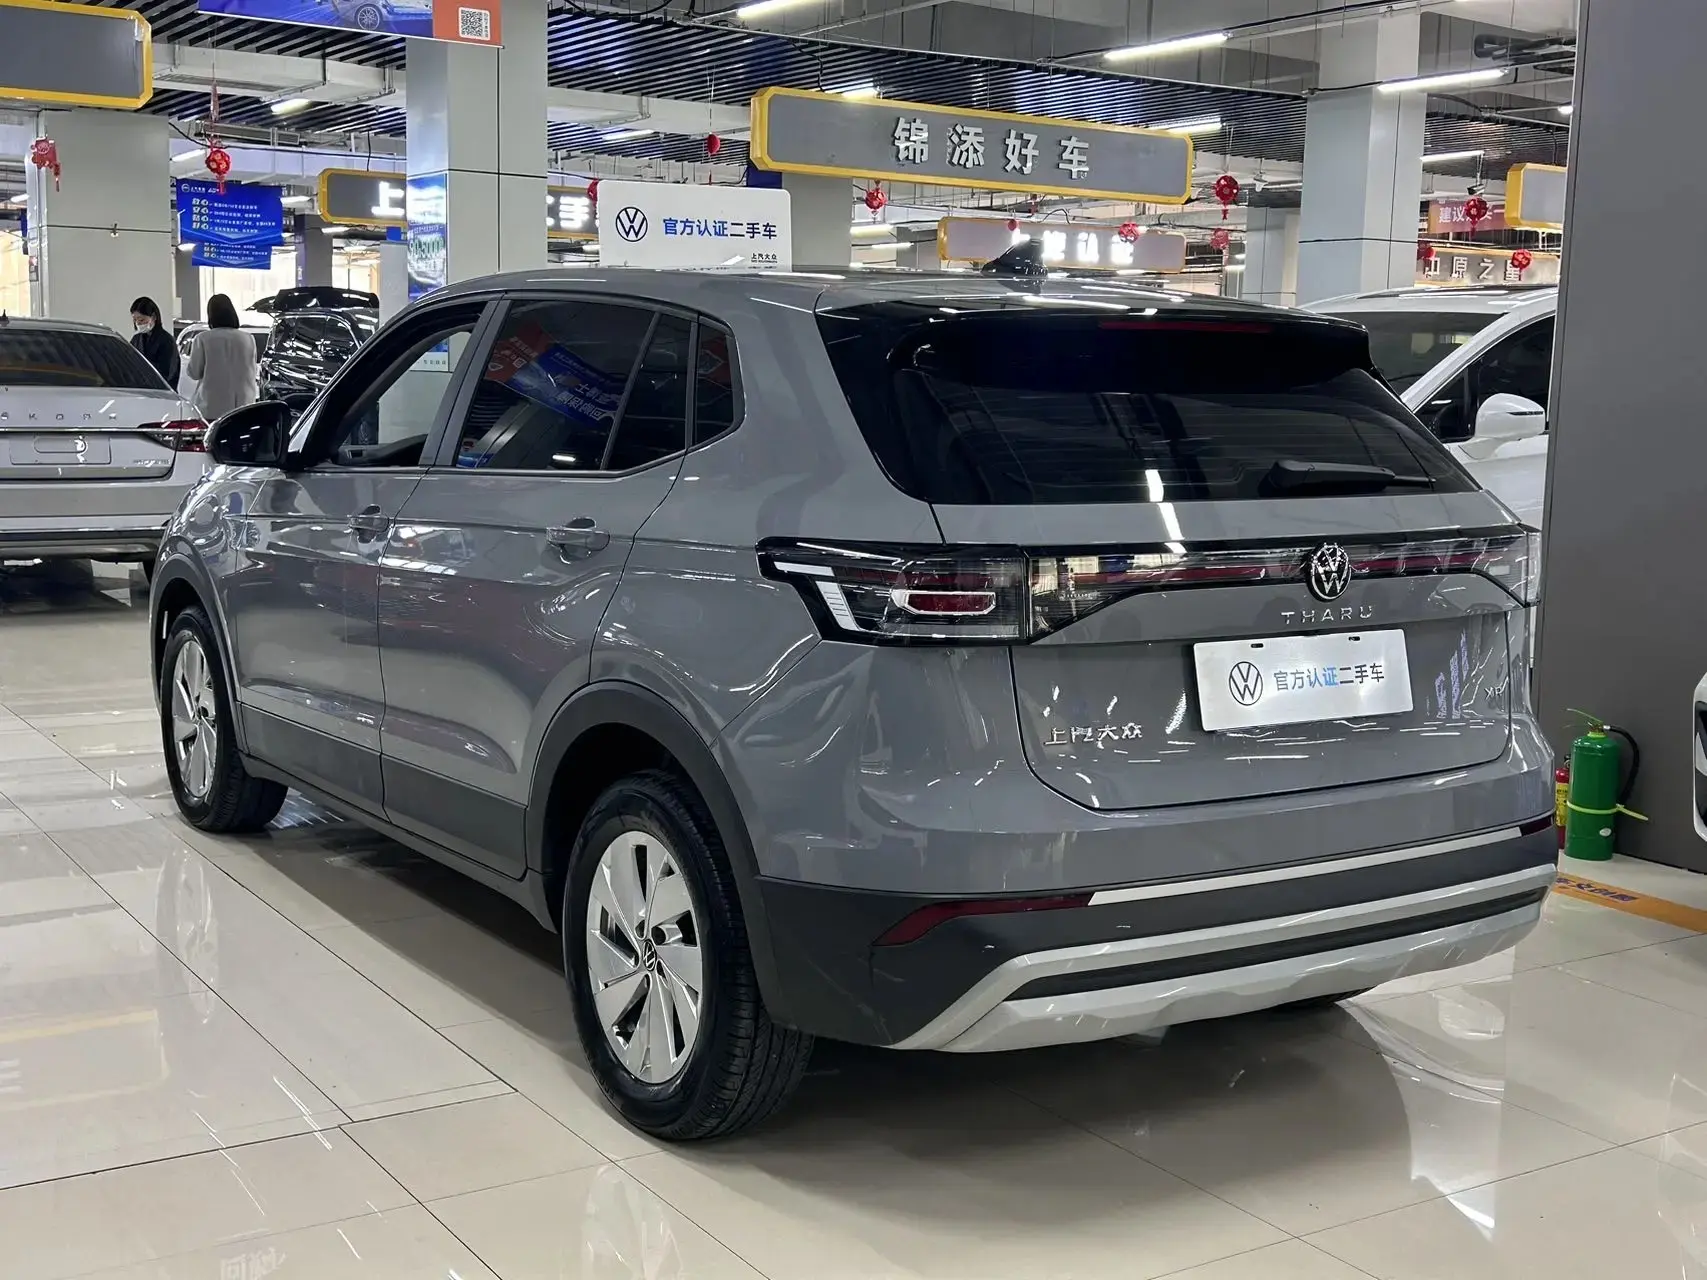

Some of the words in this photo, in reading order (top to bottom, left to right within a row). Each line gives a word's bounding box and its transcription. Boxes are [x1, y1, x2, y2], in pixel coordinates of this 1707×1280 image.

[894, 117, 1090, 179] 锦添好车
[663, 218, 778, 240] 官方认证二手车
[1281, 605, 1373, 625] THARU
[1273, 663, 1385, 691] 官方认证二手车
